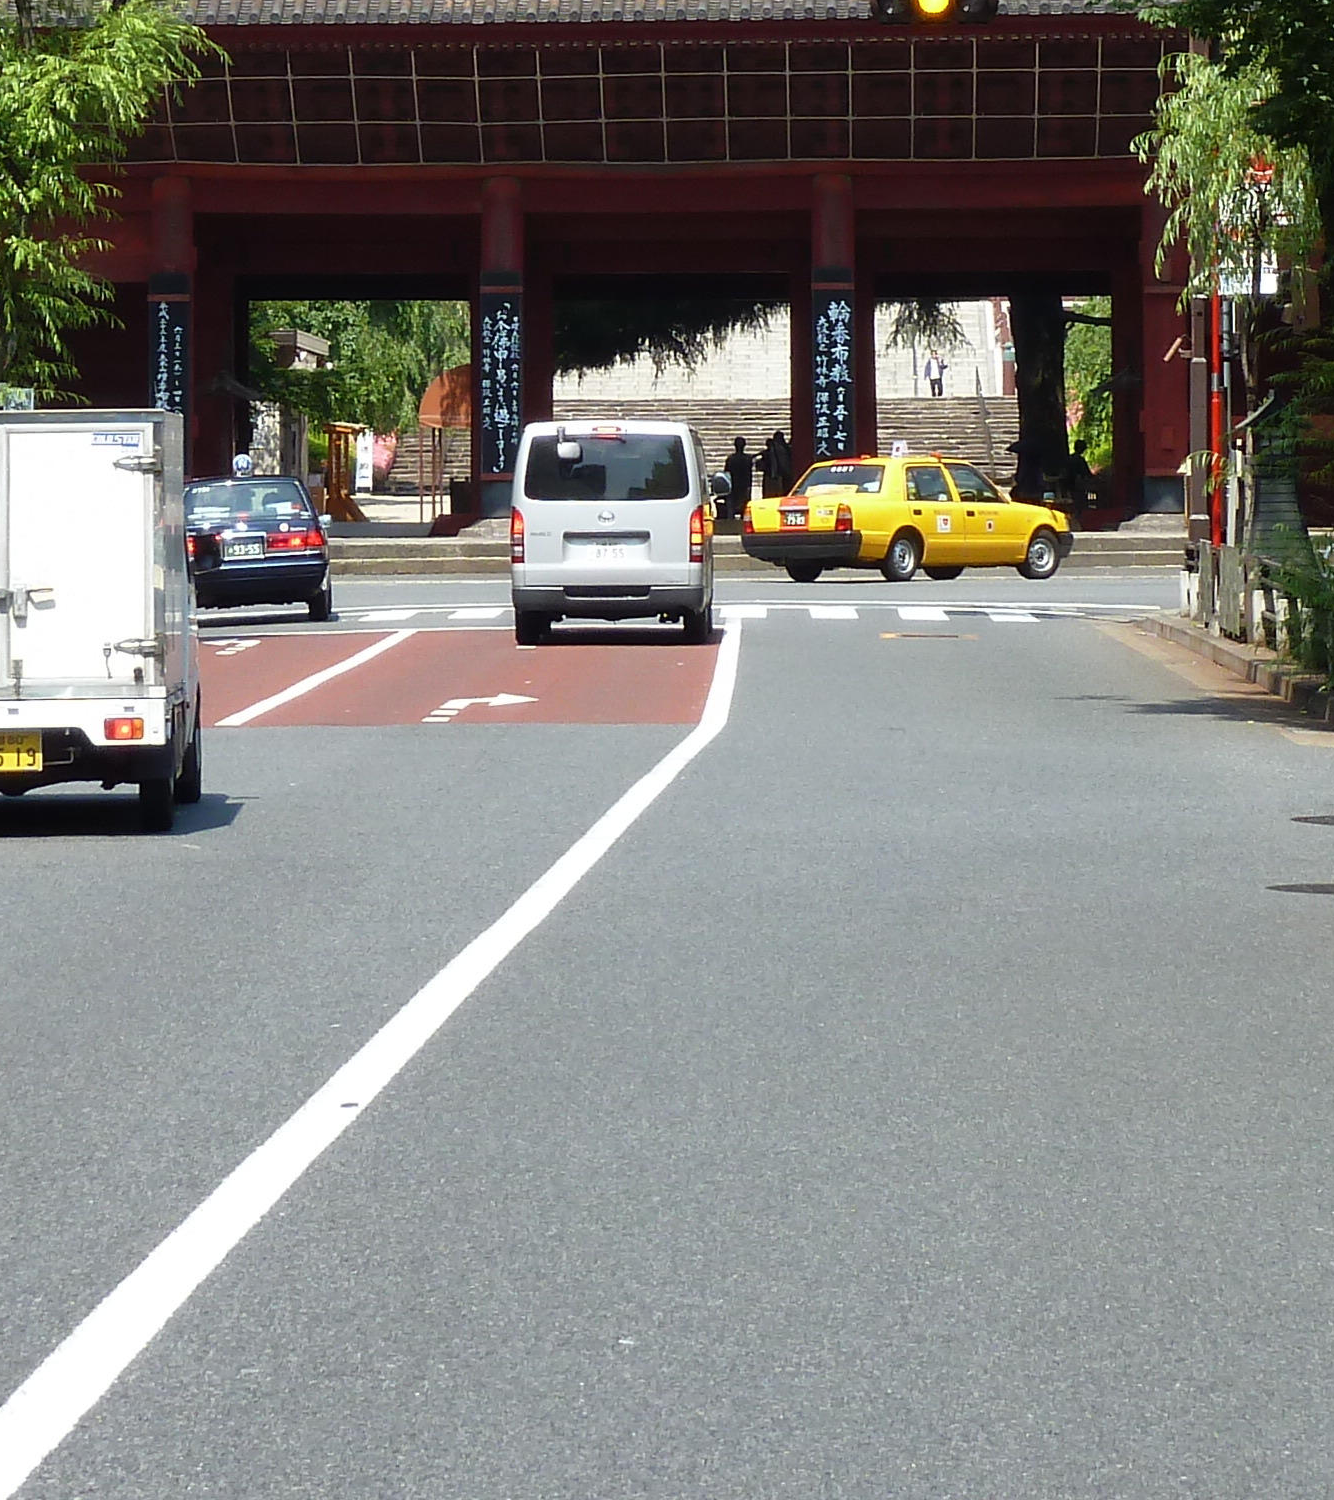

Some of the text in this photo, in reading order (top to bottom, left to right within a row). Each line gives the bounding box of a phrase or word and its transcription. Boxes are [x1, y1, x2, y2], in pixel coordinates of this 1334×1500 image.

[827, 300, 853, 383] 輪番布教
[233, 544, 260, 555] 93-55
